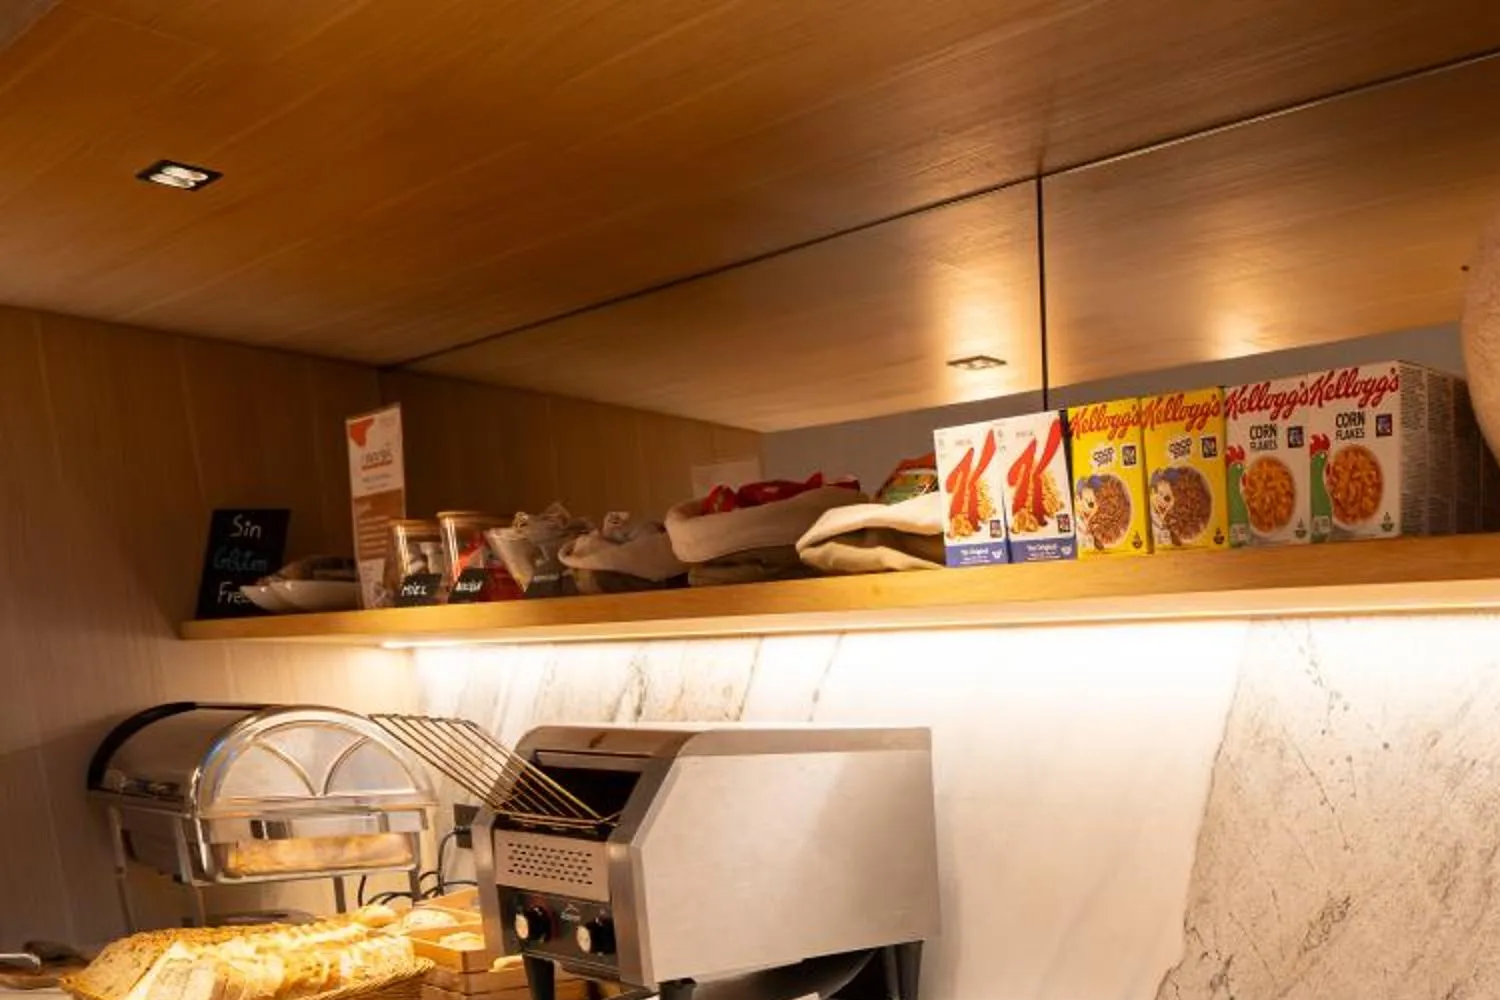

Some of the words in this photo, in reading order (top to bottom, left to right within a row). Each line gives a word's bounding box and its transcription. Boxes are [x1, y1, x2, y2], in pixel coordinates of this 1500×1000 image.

[1223, 380, 1309, 421] Kellogg's
[1309, 367, 1400, 408] Kellogg's
[1069, 404, 1142, 440] Kellogg's
[1141, 393, 1221, 432] Kellogg's
[1335, 411, 1366, 428] CORN
[1249, 423, 1278, 440] CORN
[1335, 428, 1366, 440] FLAKES
[230, 513, 262, 539] Sin
